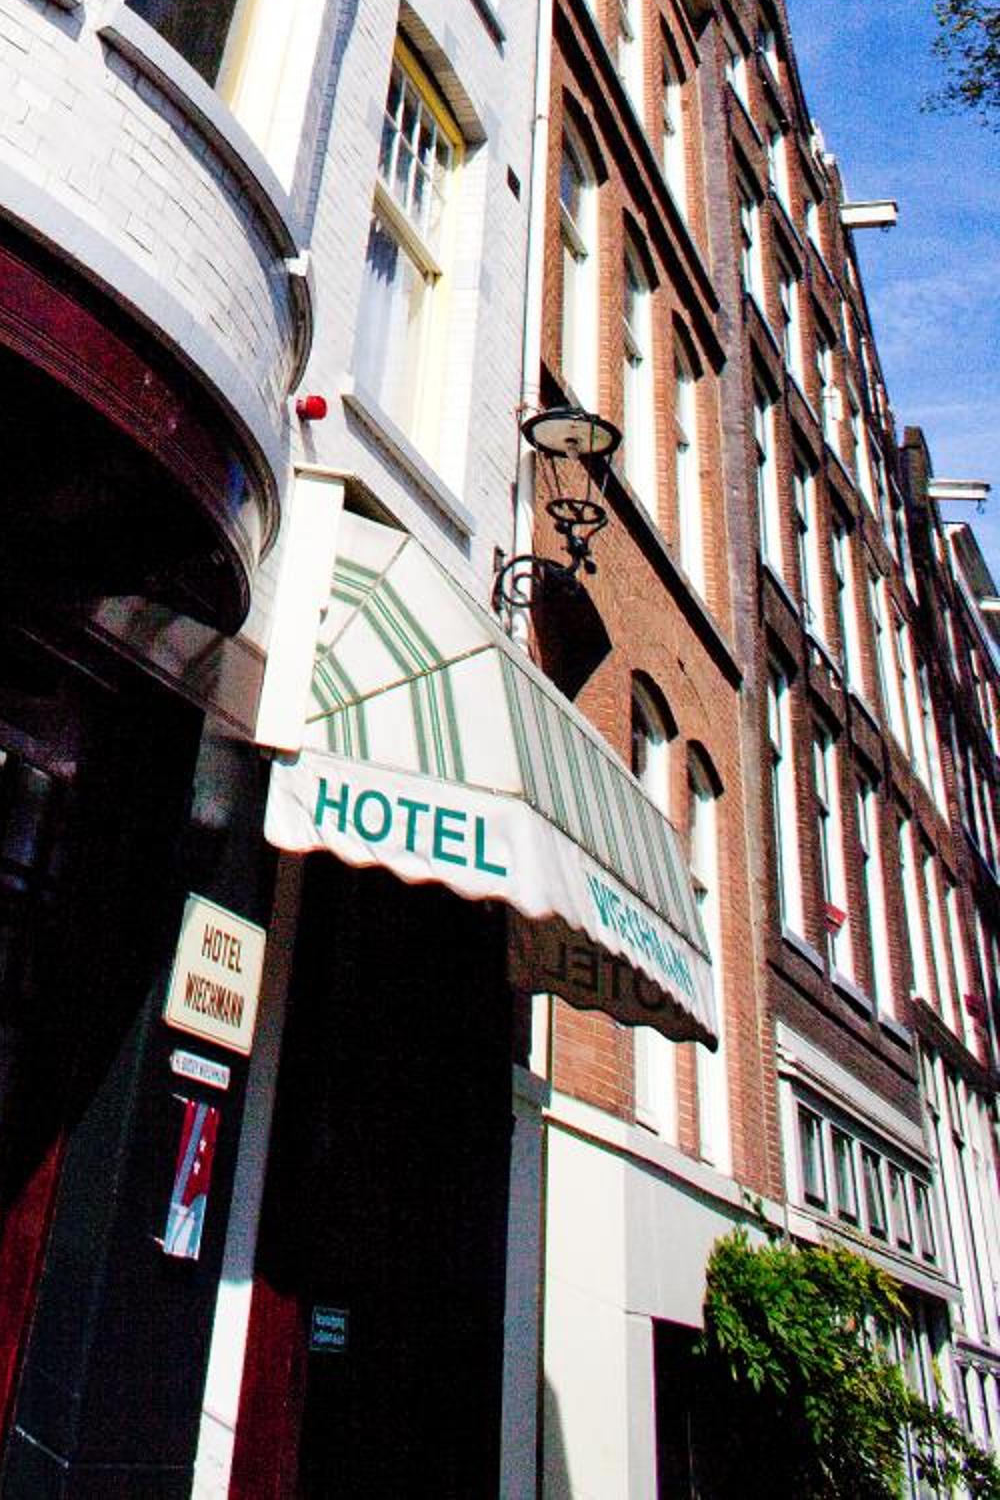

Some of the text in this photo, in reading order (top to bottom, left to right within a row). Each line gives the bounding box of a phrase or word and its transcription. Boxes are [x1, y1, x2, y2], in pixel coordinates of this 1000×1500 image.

[314, 777, 507, 877] HOTEL
[201, 923, 242, 974] HOTEL
[184, 971, 245, 1029] WIECHMANN
